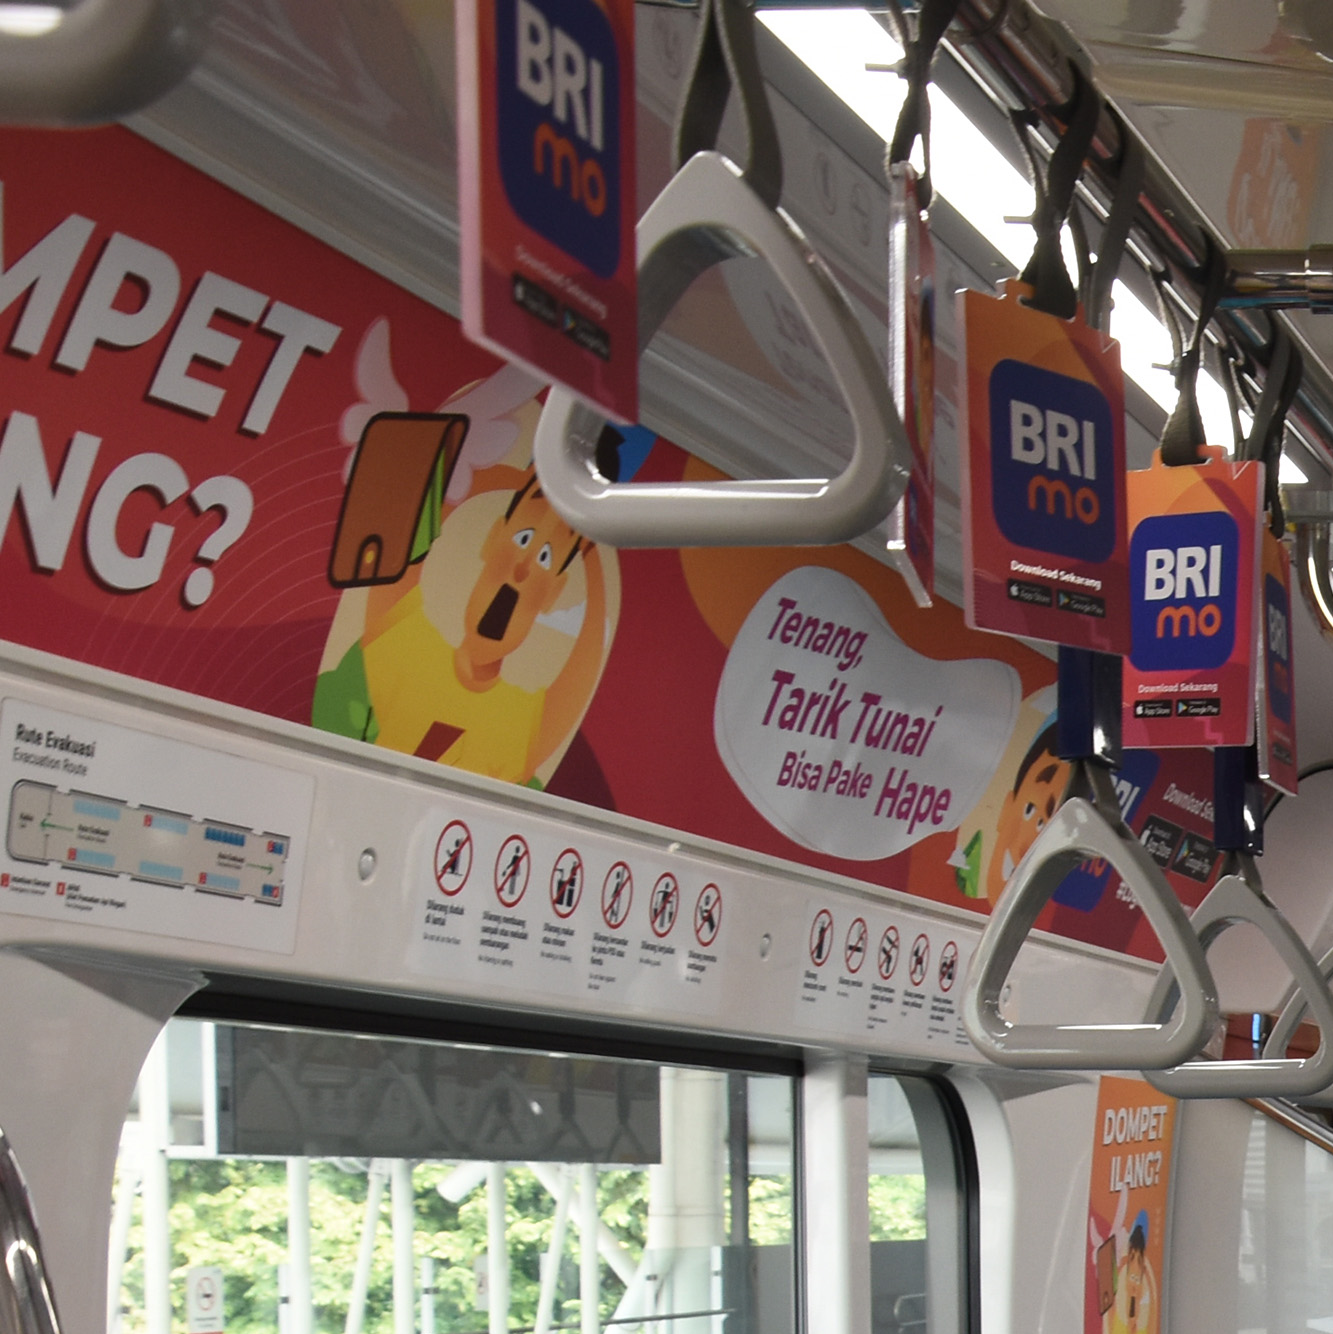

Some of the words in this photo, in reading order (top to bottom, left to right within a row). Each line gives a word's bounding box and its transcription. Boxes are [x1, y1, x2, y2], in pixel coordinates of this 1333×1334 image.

[516, 0, 604, 152] BRI
[533, 122, 607, 217] mo
[1010, 399, 1097, 480] BRI
[1028, 474, 1100, 524] mo
[1010, 559, 1060, 580] Download
[1059, 570, 1102, 592] Sekarang
[1144, 544, 1222, 601] BRI
[768, 597, 869, 672] Tenang,
[1156, 604, 1222, 639] mo
[762, 669, 852, 740] Tarik
[849, 692, 944, 757] Tunai
[1138, 683, 1179, 694] Download
[1180, 682, 1218, 693] Sekarang
[776, 750, 823, 791] Bisa
[823, 759, 873, 799] Pake
[873, 767, 952, 835] Hape
[1102, 1105, 1168, 1147] DOMPET
[1110, 1151, 1163, 1192] ILANG?
